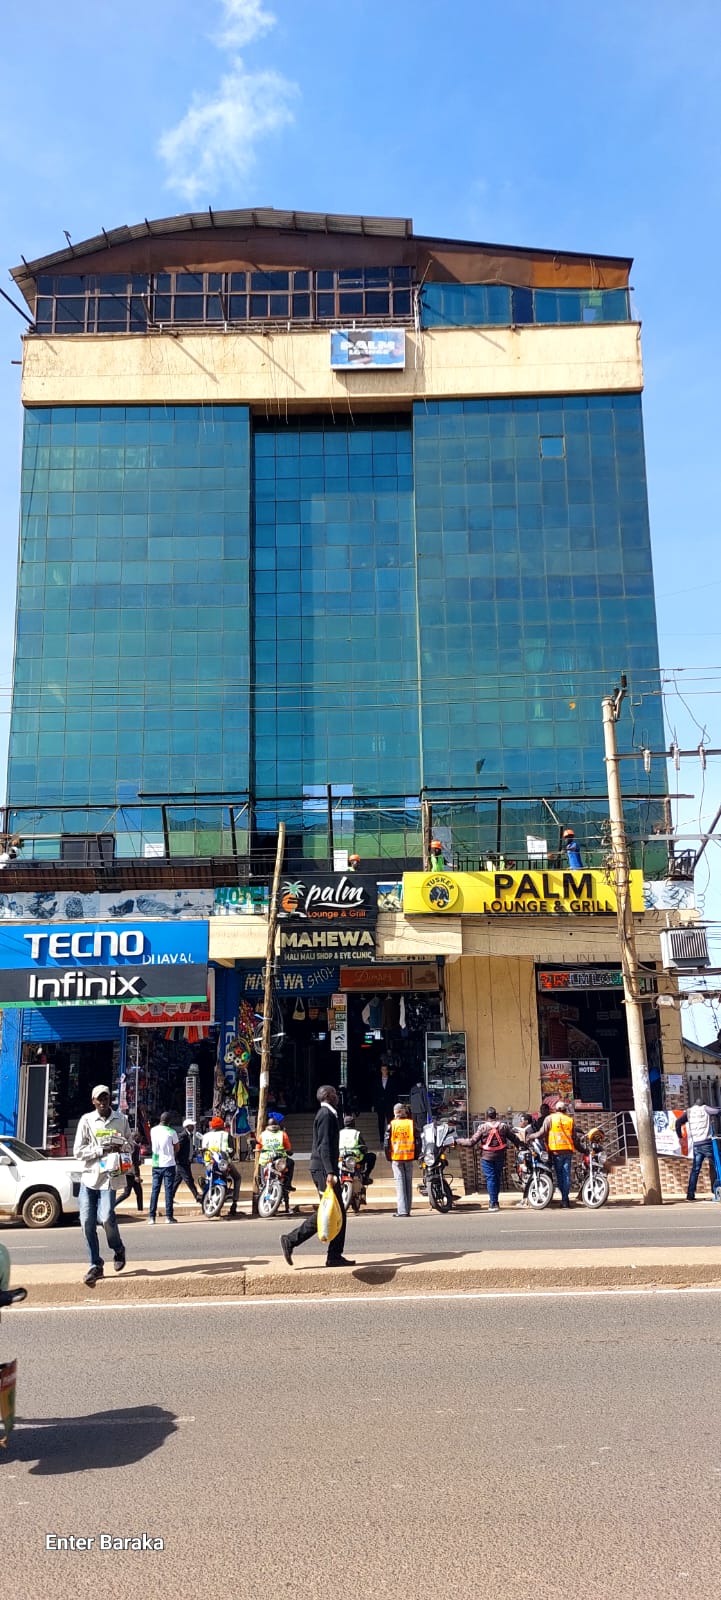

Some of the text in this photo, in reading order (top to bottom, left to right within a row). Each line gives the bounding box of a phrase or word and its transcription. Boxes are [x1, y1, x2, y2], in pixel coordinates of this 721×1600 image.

[340, 341, 395, 350] PALM
[426, 877, 454, 890] TUSKER
[494, 873, 592, 899] PALM
[304, 876, 365, 912] palm
[307, 911, 338, 919] Lounge
[349, 909, 366, 917] Grill
[483, 900, 613, 912] LOUNGE & GRILL
[23, 930, 144, 959] TECNO
[281, 931, 374, 947] MAHEWA
[29, 970, 140, 998] Infinix
[245, 973, 304, 990] MAEWA
